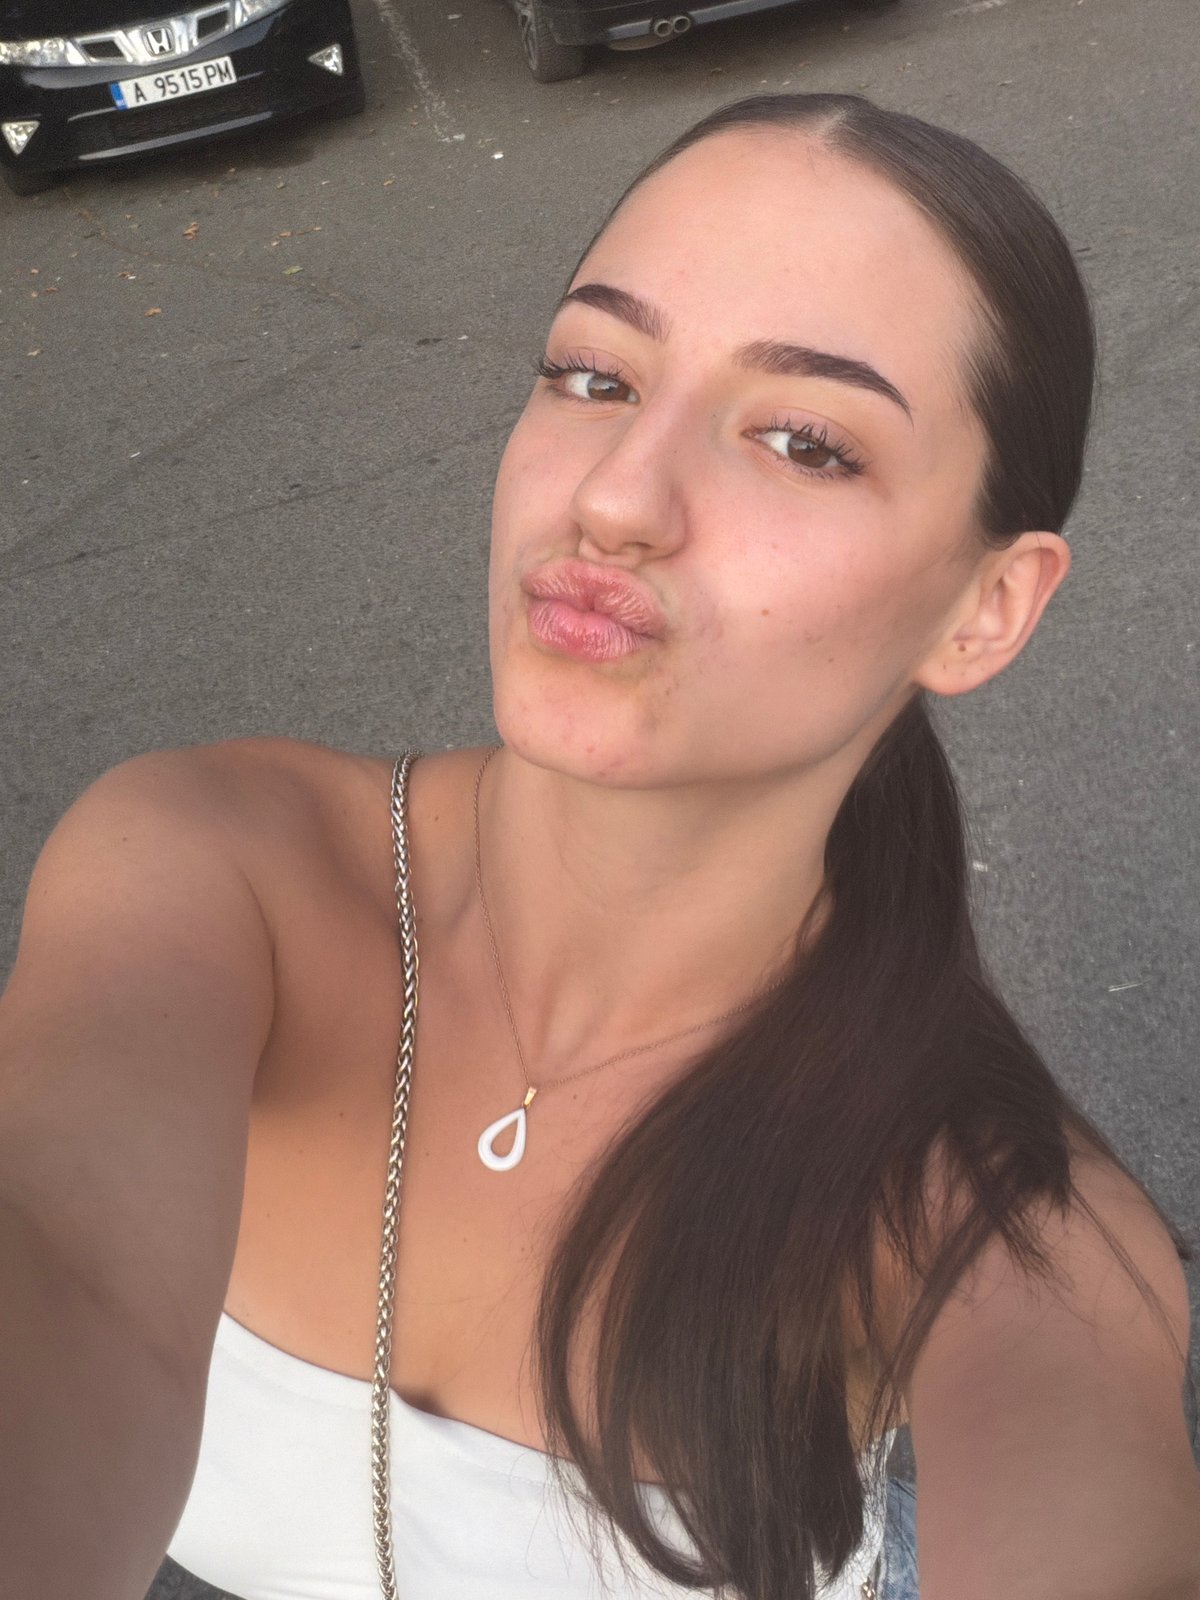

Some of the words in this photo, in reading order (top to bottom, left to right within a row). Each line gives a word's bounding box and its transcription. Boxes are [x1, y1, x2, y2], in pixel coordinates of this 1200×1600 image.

[134, 82, 147, 103] A
[154, 69, 203, 97] 9515
[204, 60, 233, 86] PM
